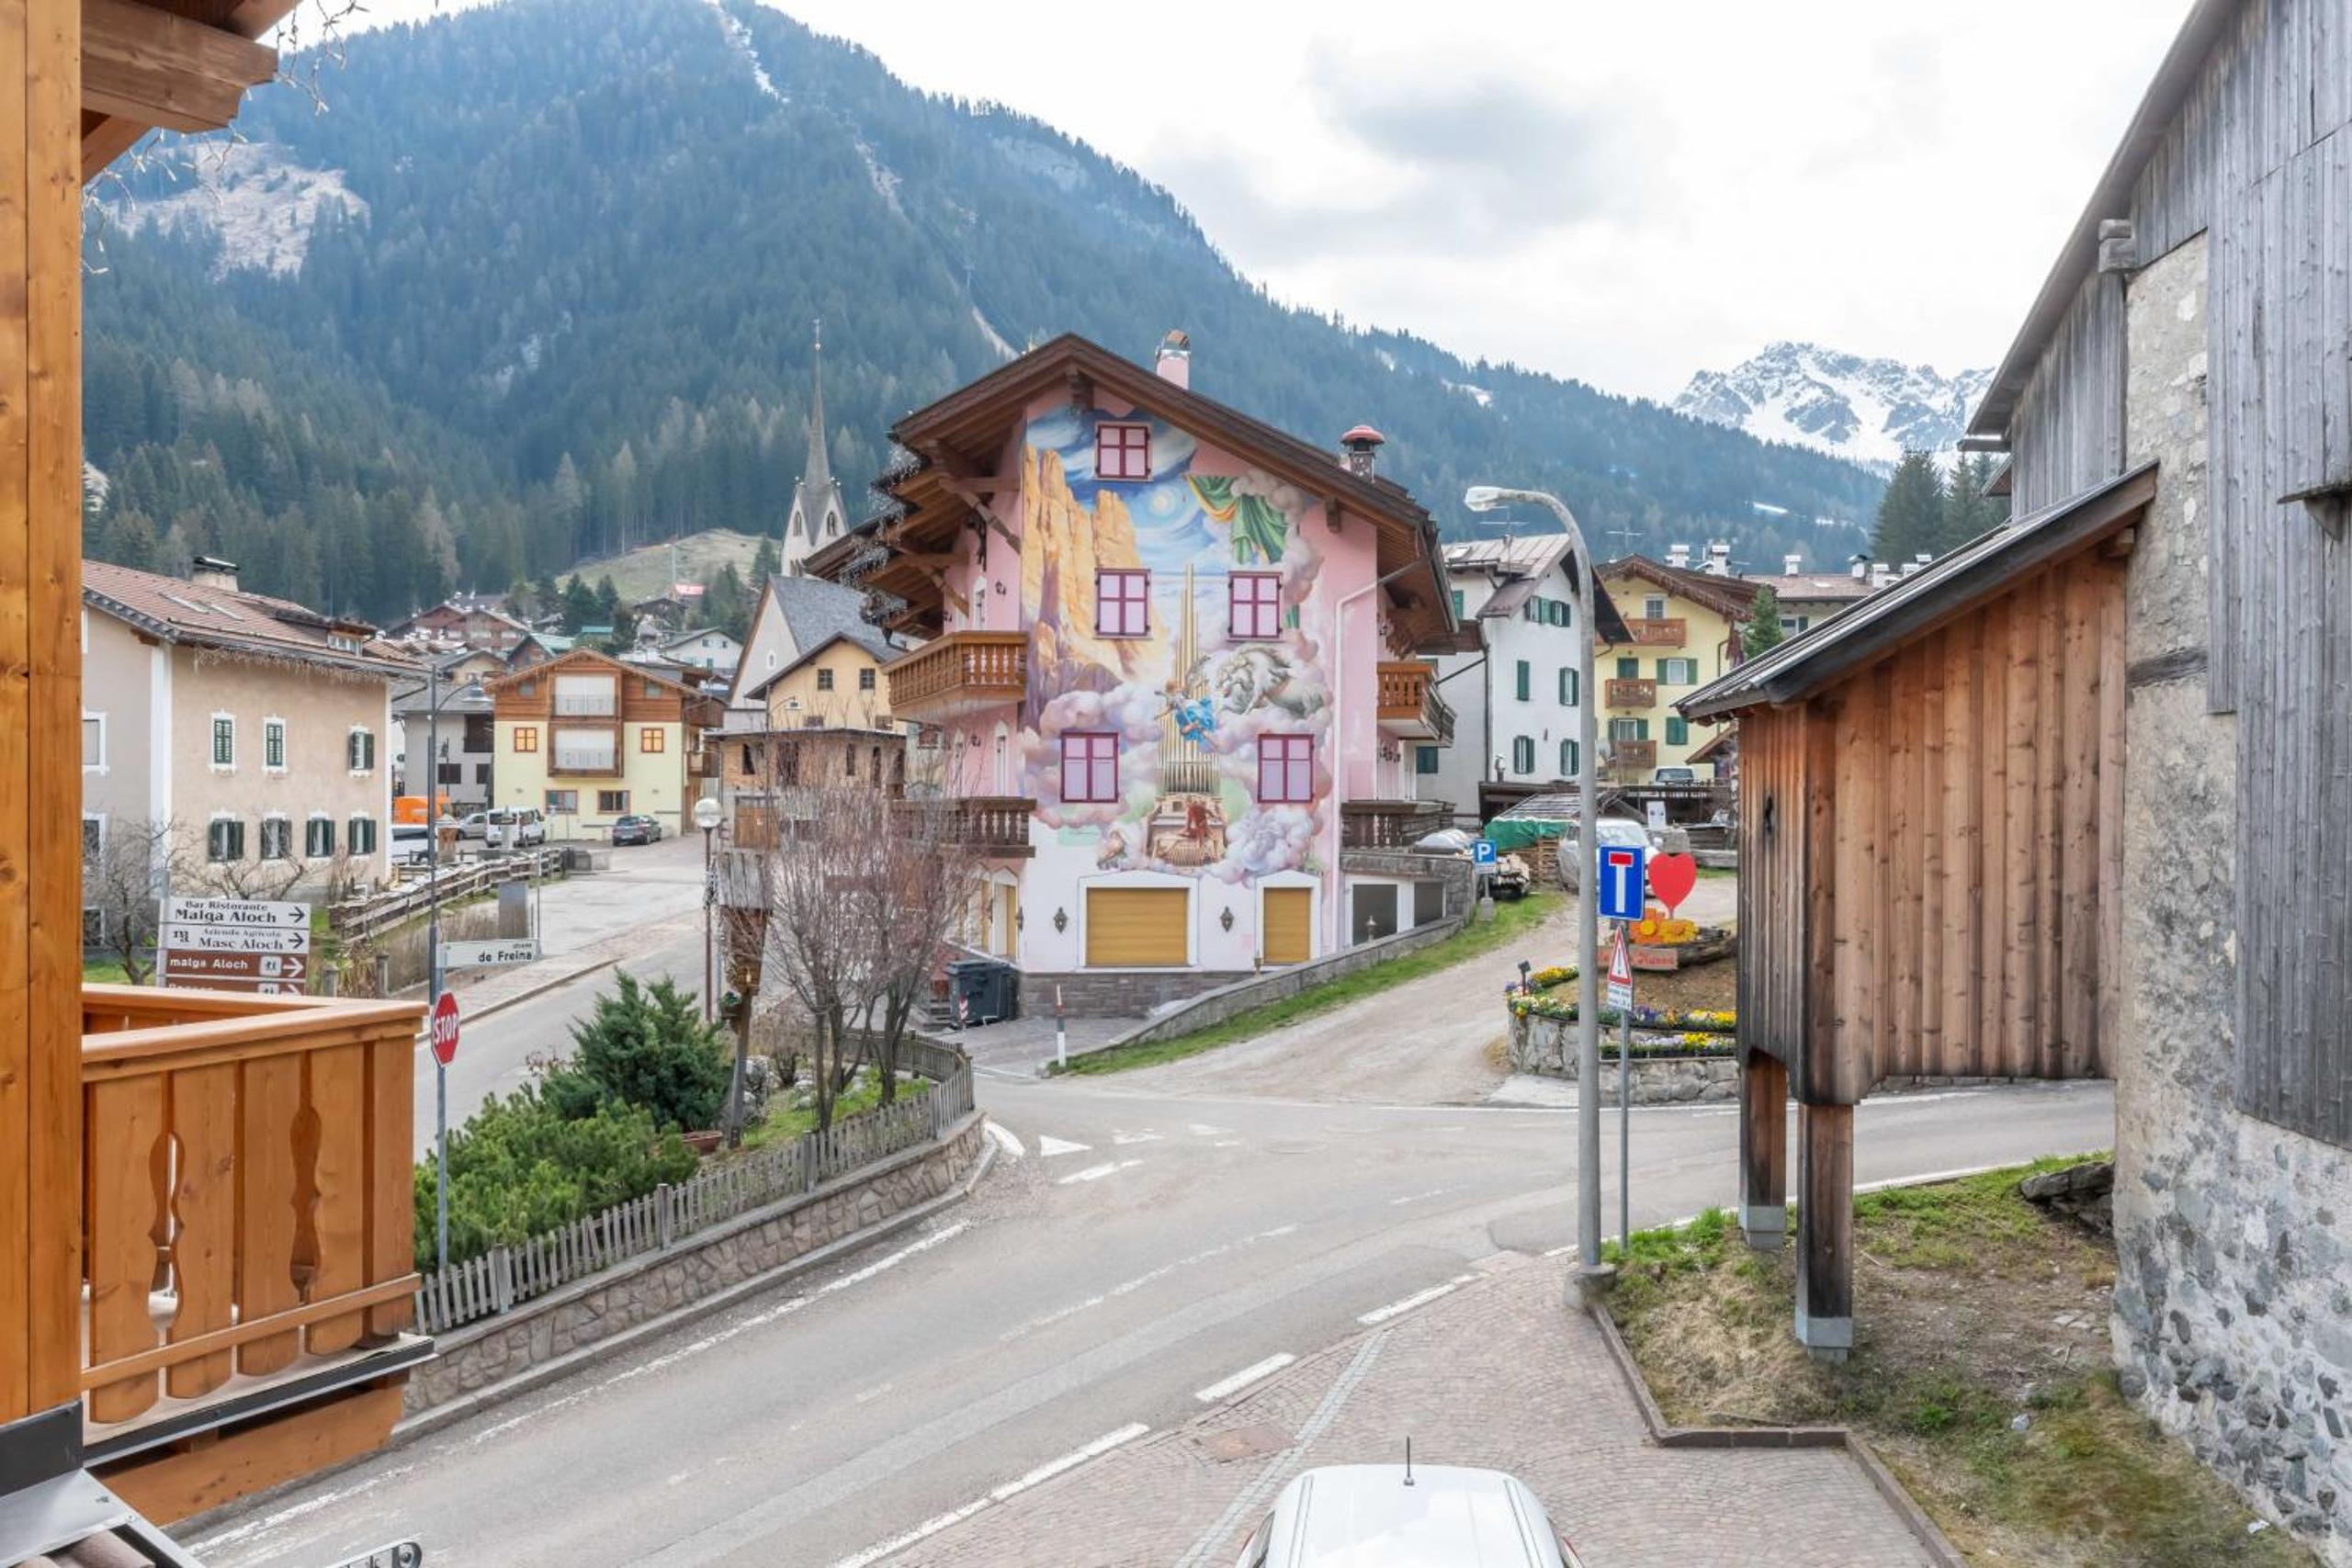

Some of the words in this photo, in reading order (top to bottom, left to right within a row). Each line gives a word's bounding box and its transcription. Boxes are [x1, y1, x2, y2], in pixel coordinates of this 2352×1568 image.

[1477, 842, 1492, 861] P
[186, 900, 204, 908] Bar
[209, 901, 268, 911] Ristorante
[175, 908, 224, 922] Malga
[230, 911, 277, 923] Aloch
[198, 937, 236, 948] Masc
[241, 938, 283, 950] Aloch
[478, 952, 492, 963] de
[498, 951, 532, 962] Freina
[169, 958, 207, 969] malga
[212, 959, 248, 970] Aloch
[435, 1013, 458, 1044] STOP
